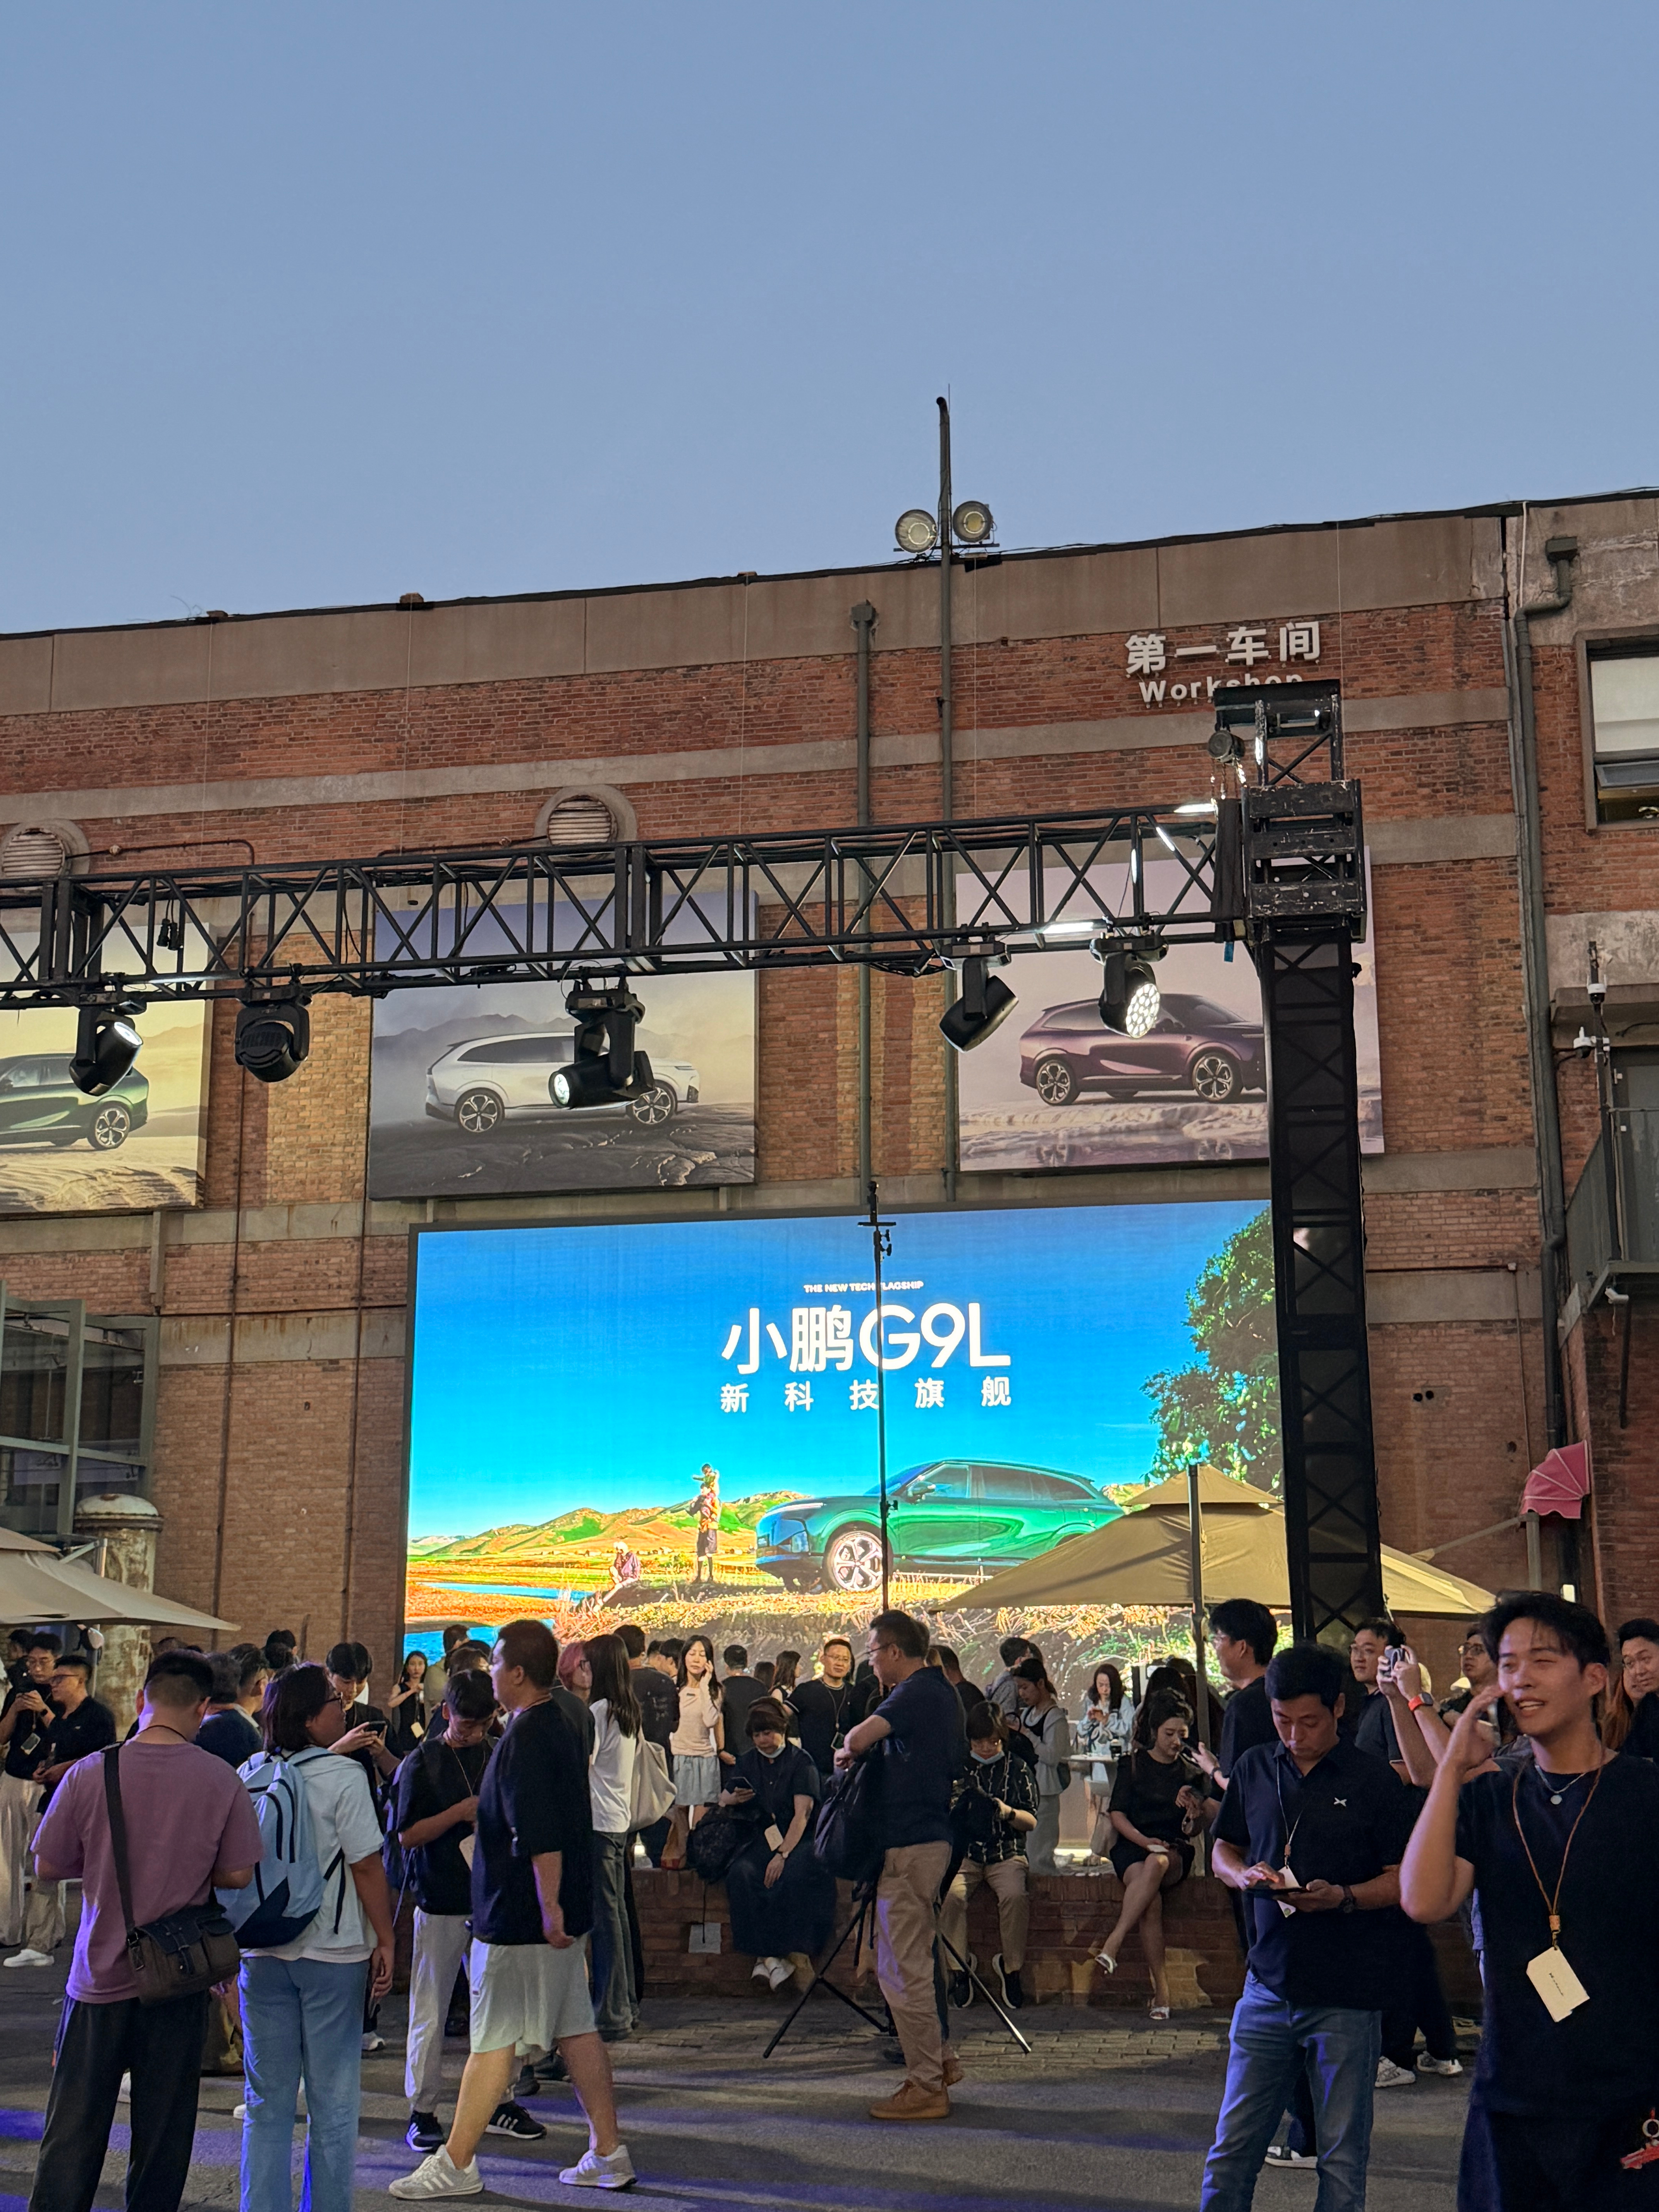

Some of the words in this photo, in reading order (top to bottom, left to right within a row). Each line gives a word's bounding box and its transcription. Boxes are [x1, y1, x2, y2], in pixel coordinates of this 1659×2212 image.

[1124, 621, 1320, 675] 第一车间
[803, 1284, 823, 1293] THE
[824, 1283, 848, 1292] NEW
[848, 1282, 875, 1291] TECH
[880, 1281, 924, 1290] LAGSHIP
[721, 1302, 1011, 1374] 小鹏G9L
[720, 1376, 1012, 1413] 新科技旗舰
